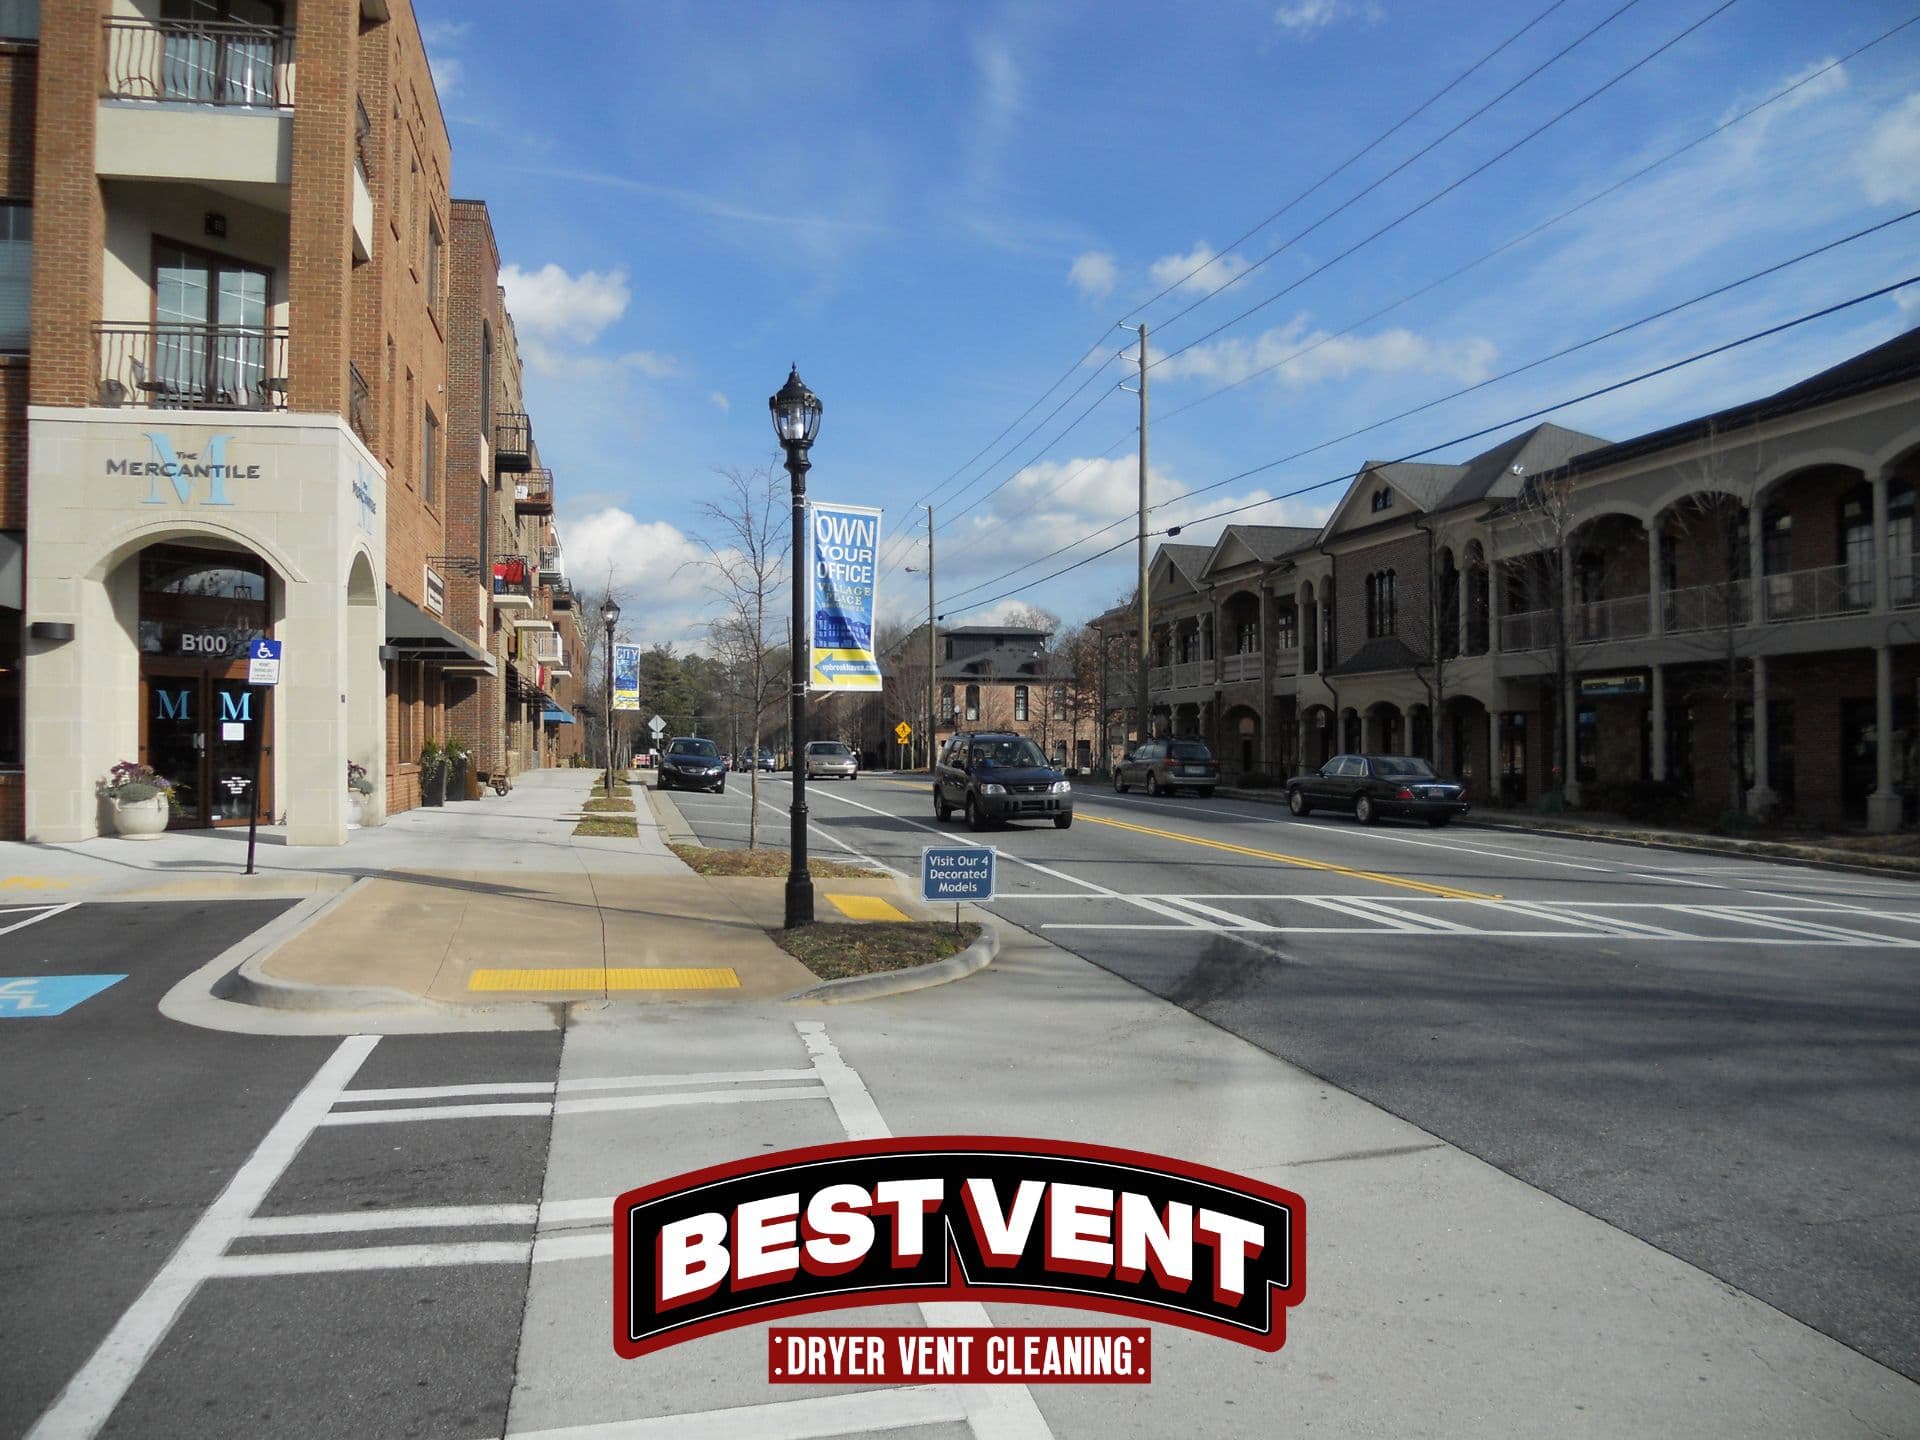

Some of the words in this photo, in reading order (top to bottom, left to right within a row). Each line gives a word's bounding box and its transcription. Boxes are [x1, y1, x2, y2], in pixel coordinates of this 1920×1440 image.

[106, 458, 260, 479] MERCANTILE
[816, 515, 874, 547] OWN
[818, 543, 872, 563] YOUR
[817, 561, 871, 584] OFFICE
[817, 582, 872, 596] VILLAGE
[826, 592, 862, 606] PLACE
[182, 634, 227, 653] B100
[155, 689, 192, 720] M
[219, 691, 252, 721] M
[929, 855, 954, 866] Visit
[957, 855, 978, 866] Our
[981, 855, 989, 866] 4
[930, 868, 987, 879] Decorated
[938, 881, 977, 893] Models
